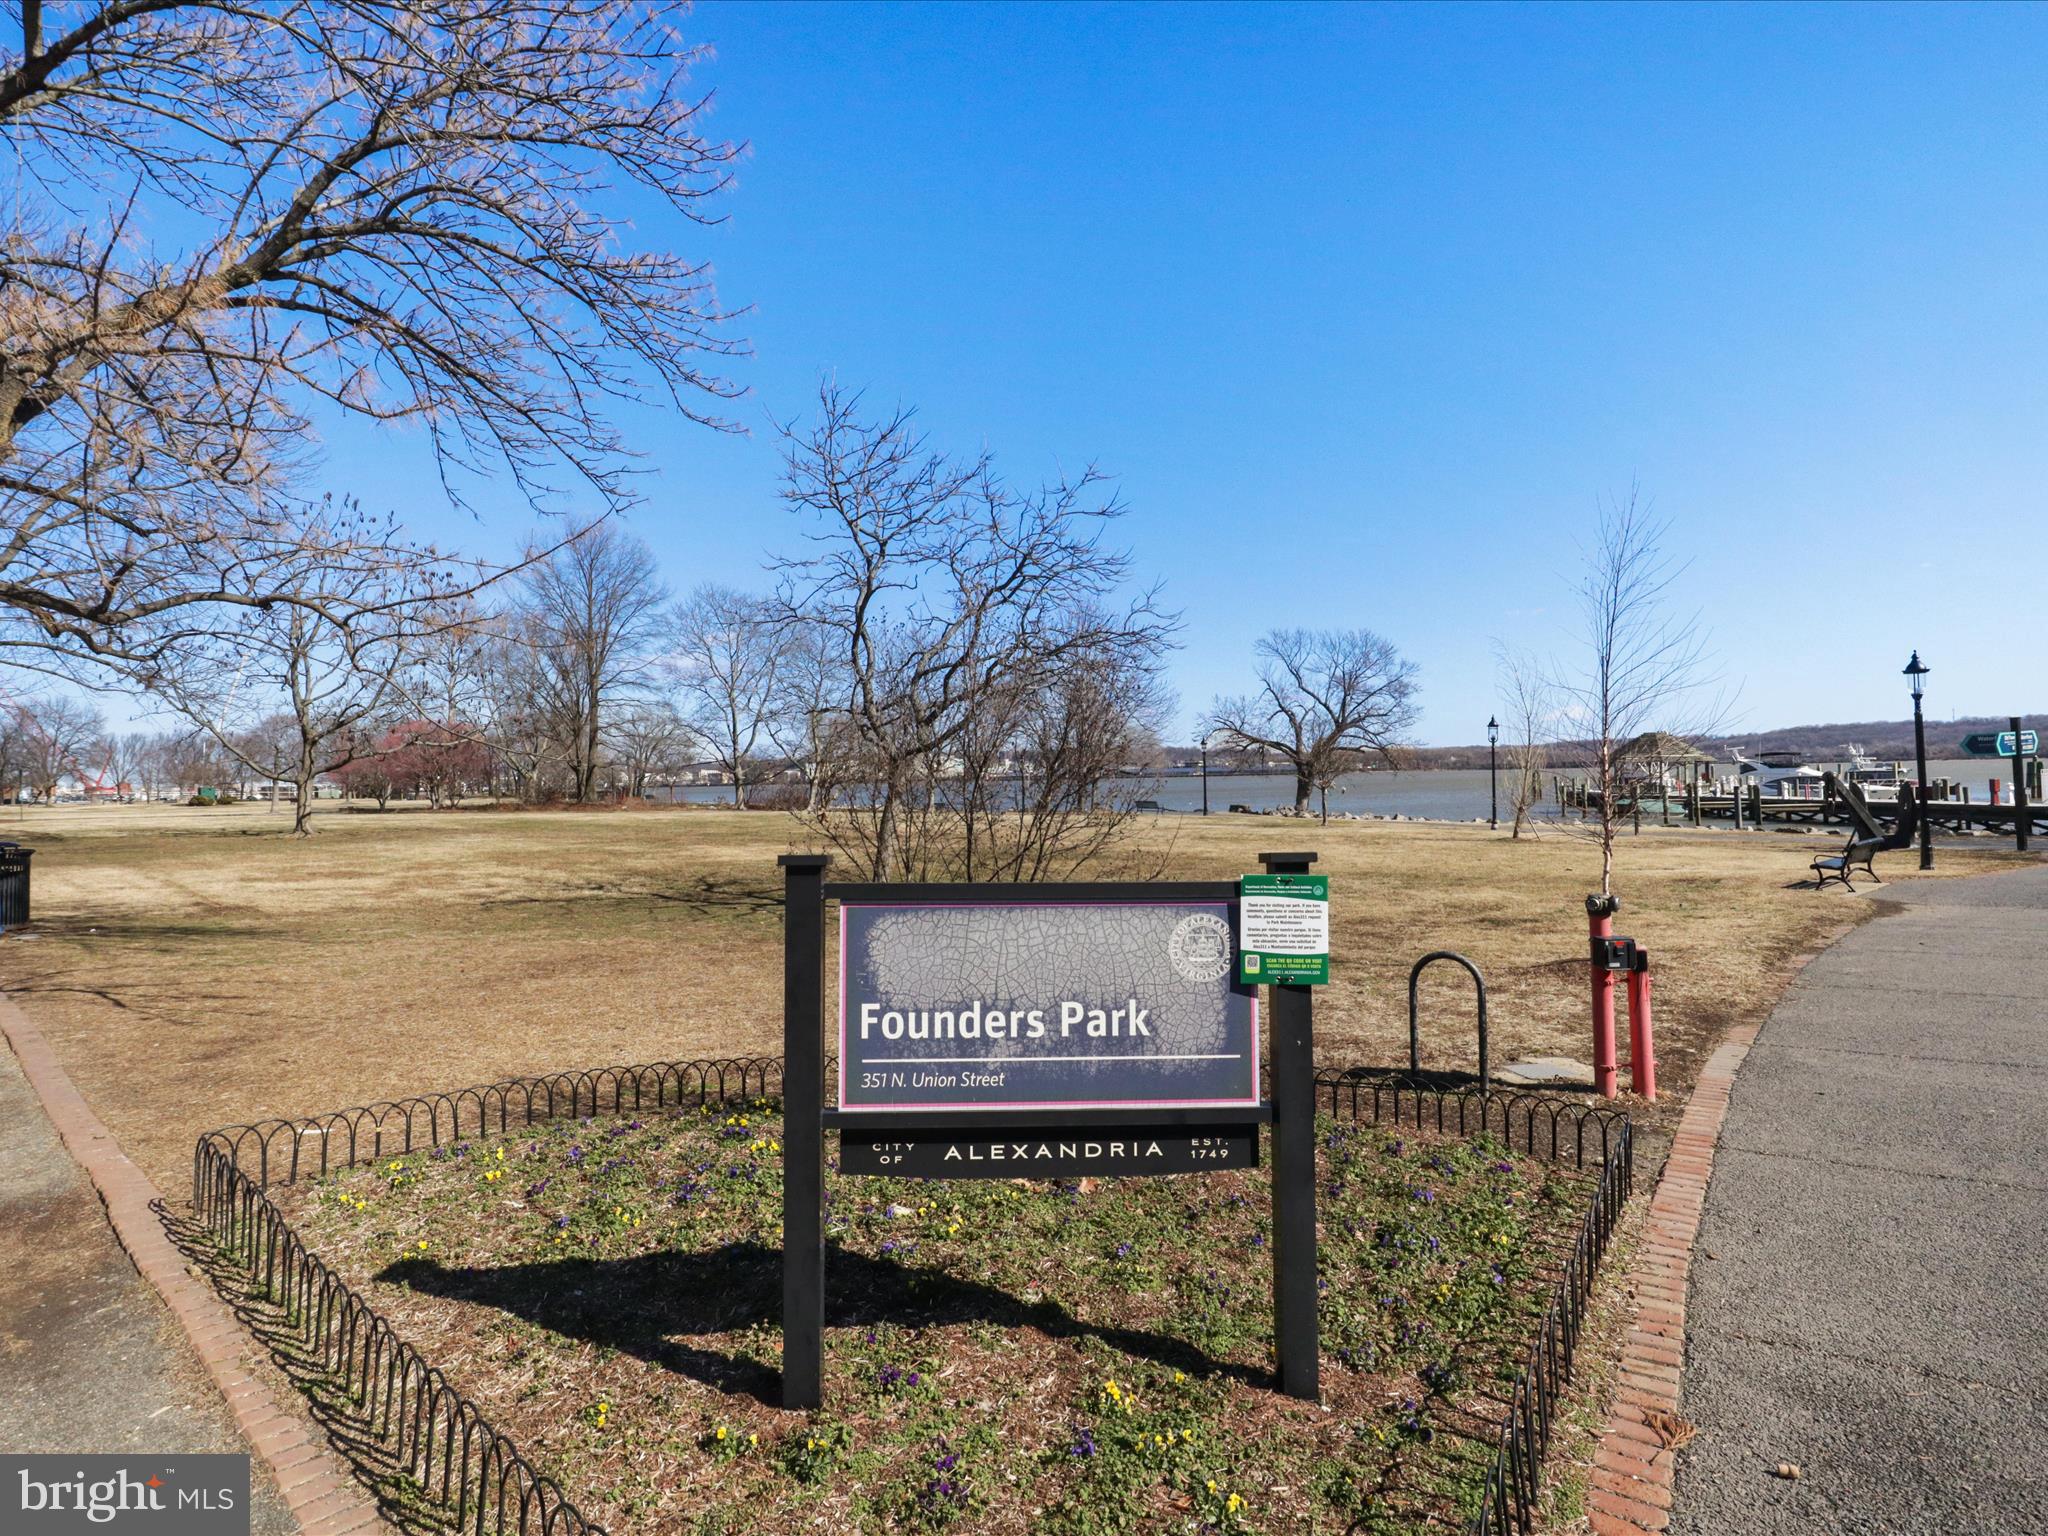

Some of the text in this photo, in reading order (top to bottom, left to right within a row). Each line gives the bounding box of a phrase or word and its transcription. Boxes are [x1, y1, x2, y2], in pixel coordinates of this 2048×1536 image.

[861, 999, 1150, 1040] Founders Park
[861, 1070, 1006, 1089] 351 N. Union Street
[1191, 1137, 1229, 1146] EST.
[872, 1143, 915, 1152] CITY
[943, 1141, 1164, 1161] ALEXANDRIA
[1190, 1149, 1229, 1159] 1749
[879, 1155, 903, 1164] OF
